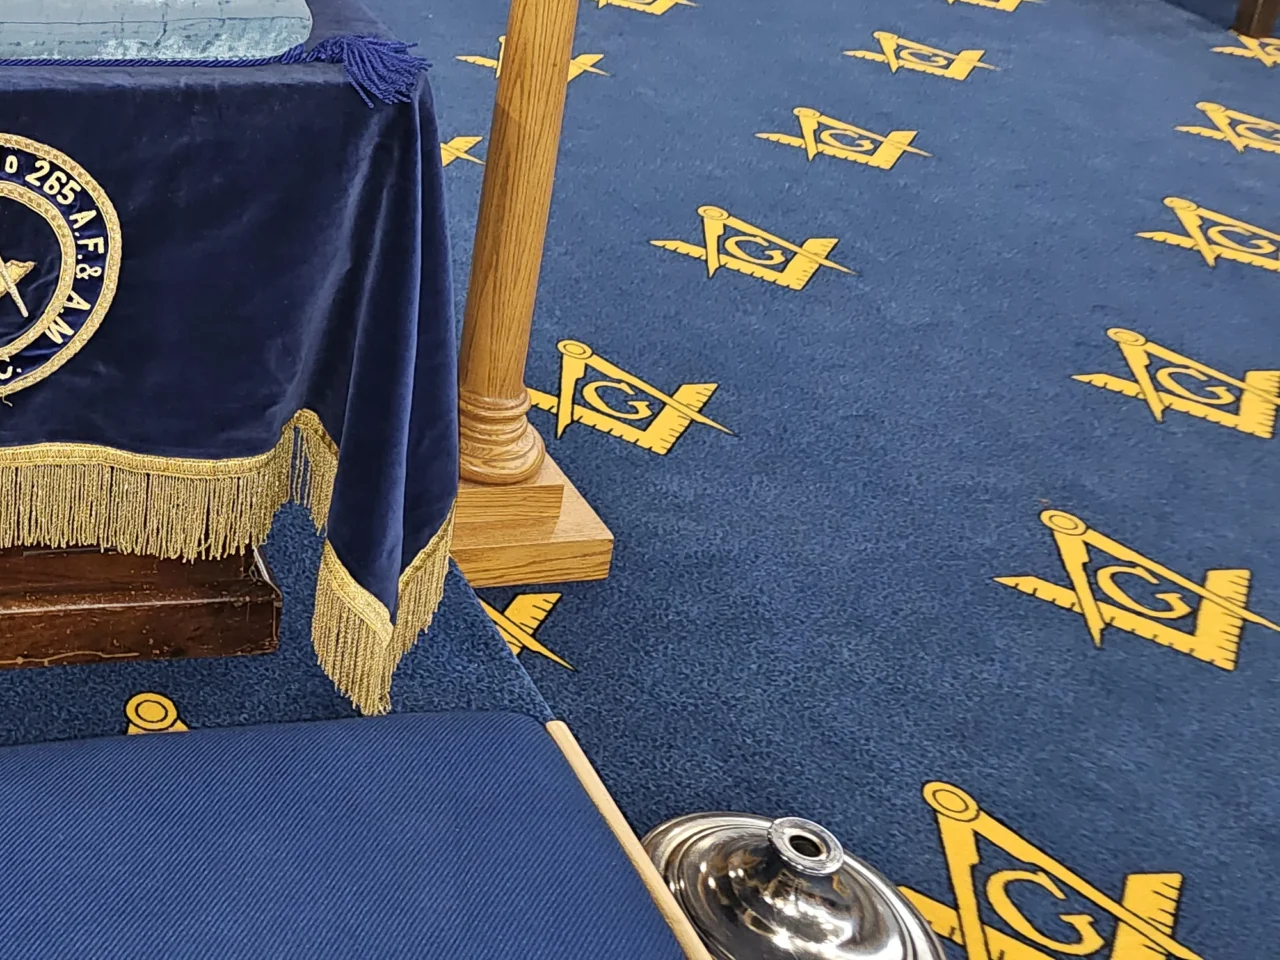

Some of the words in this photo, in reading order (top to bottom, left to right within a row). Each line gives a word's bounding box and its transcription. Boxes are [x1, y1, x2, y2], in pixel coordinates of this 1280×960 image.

[908, 51, 948, 68] G
[820, 129, 873, 151] G
[25, 160, 81, 205] 265
[724, 235, 786, 265] G
[1207, 224, 1277, 254] G
[582, 381, 652, 420] G
[1157, 368, 1234, 405] G
[1097, 566, 1191, 619] G
[986, 871, 1104, 955] G
